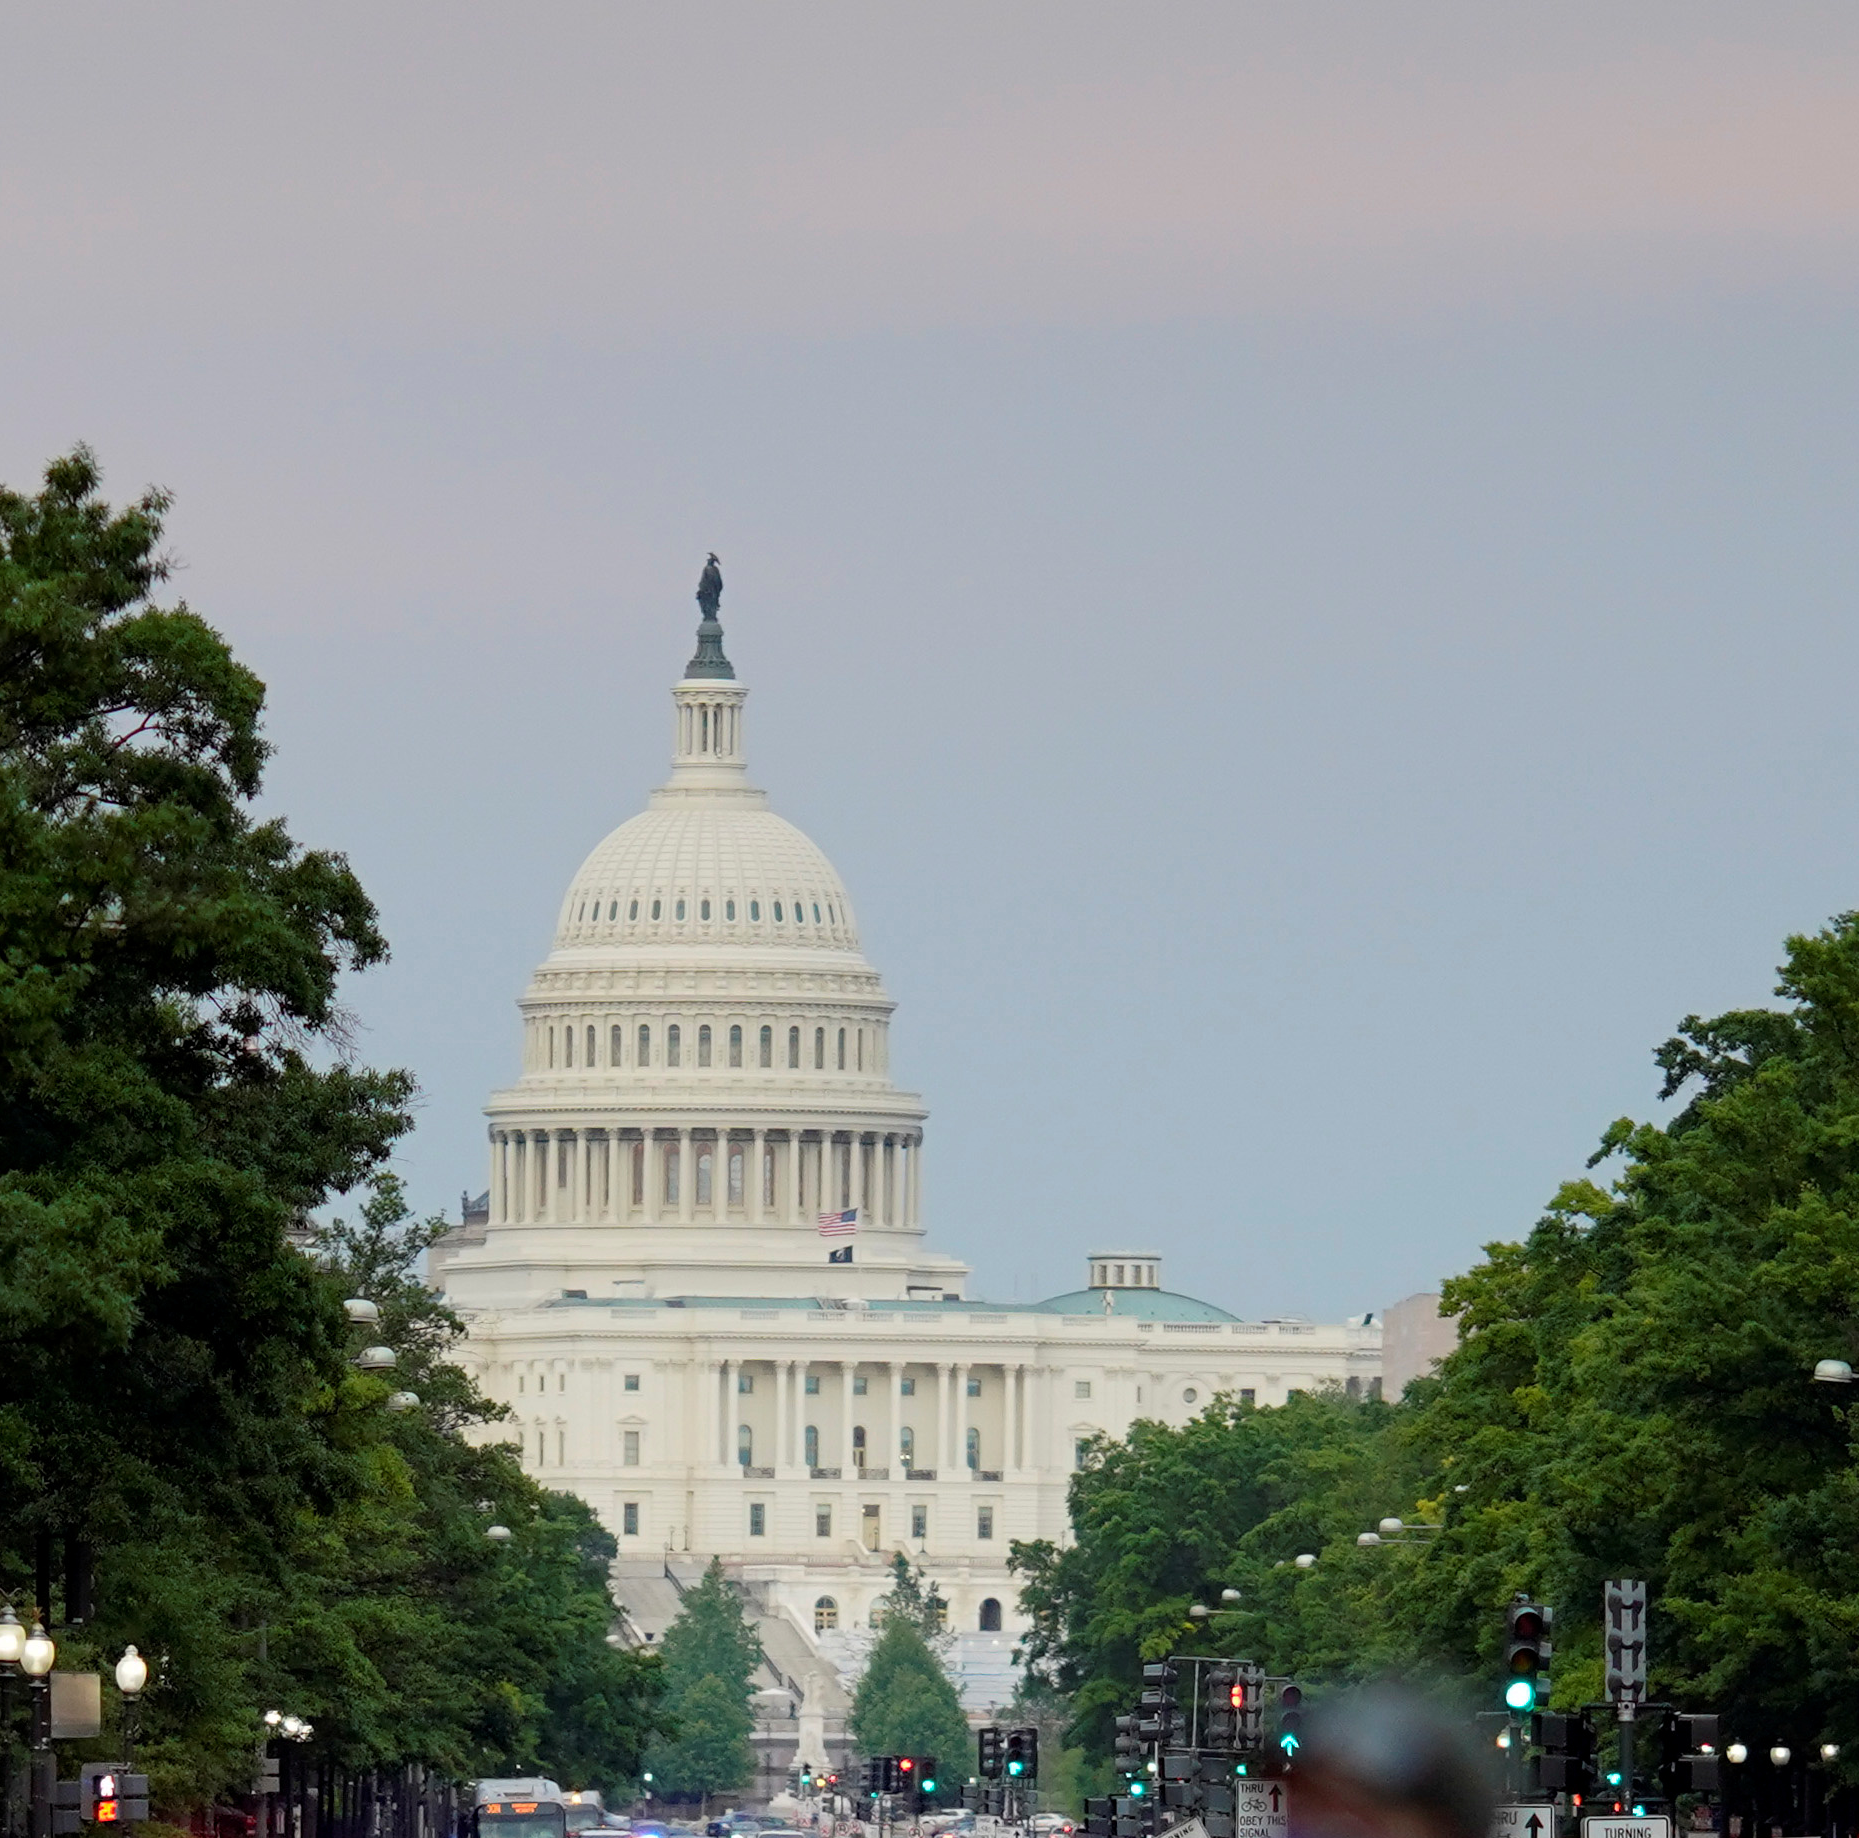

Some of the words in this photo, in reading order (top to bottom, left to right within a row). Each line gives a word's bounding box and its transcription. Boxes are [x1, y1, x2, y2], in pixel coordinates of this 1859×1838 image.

[1240, 1783, 1264, 1794] THRU
[1240, 1816, 1263, 1826] OBEY
[1267, 1816, 1287, 1826] THIS
[1240, 1828, 1271, 1838] SIGNAL
